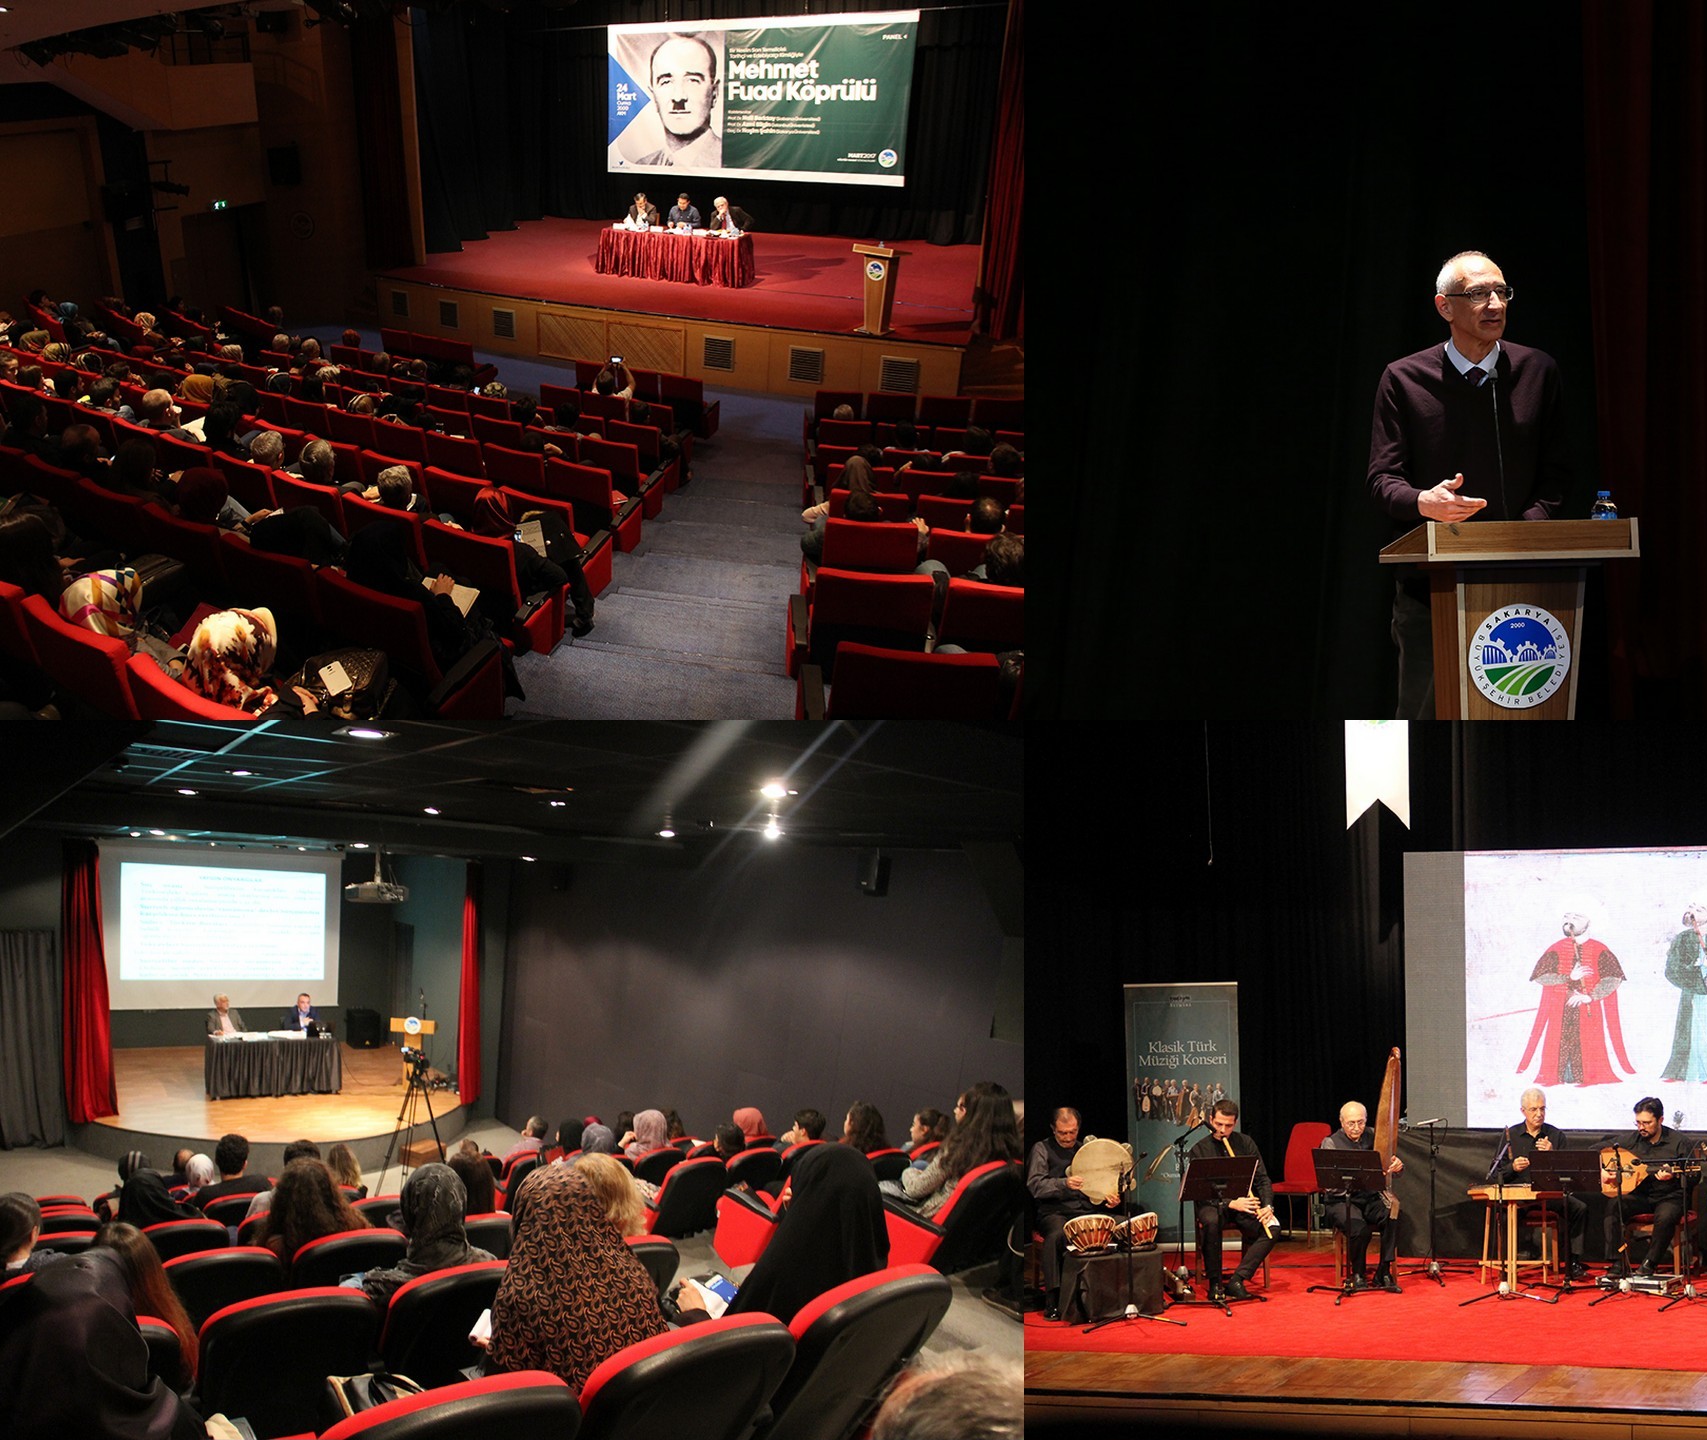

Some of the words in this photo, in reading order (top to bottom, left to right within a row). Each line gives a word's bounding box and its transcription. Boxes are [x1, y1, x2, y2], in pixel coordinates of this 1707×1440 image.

[728, 59, 819, 79] Mehmet
[616, 83, 628, 92] 24
[728, 81, 783, 101] Fuad
[786, 78, 877, 104] Köprülü
[616, 92, 637, 101] Mart
[1486, 608, 1549, 630] SAKARYA
[1149, 1040, 1185, 1053] Klasik
[1187, 1040, 1217, 1052] Türk
[1138, 1054, 1180, 1069] Müziği
[1183, 1053, 1228, 1065] Konseri
